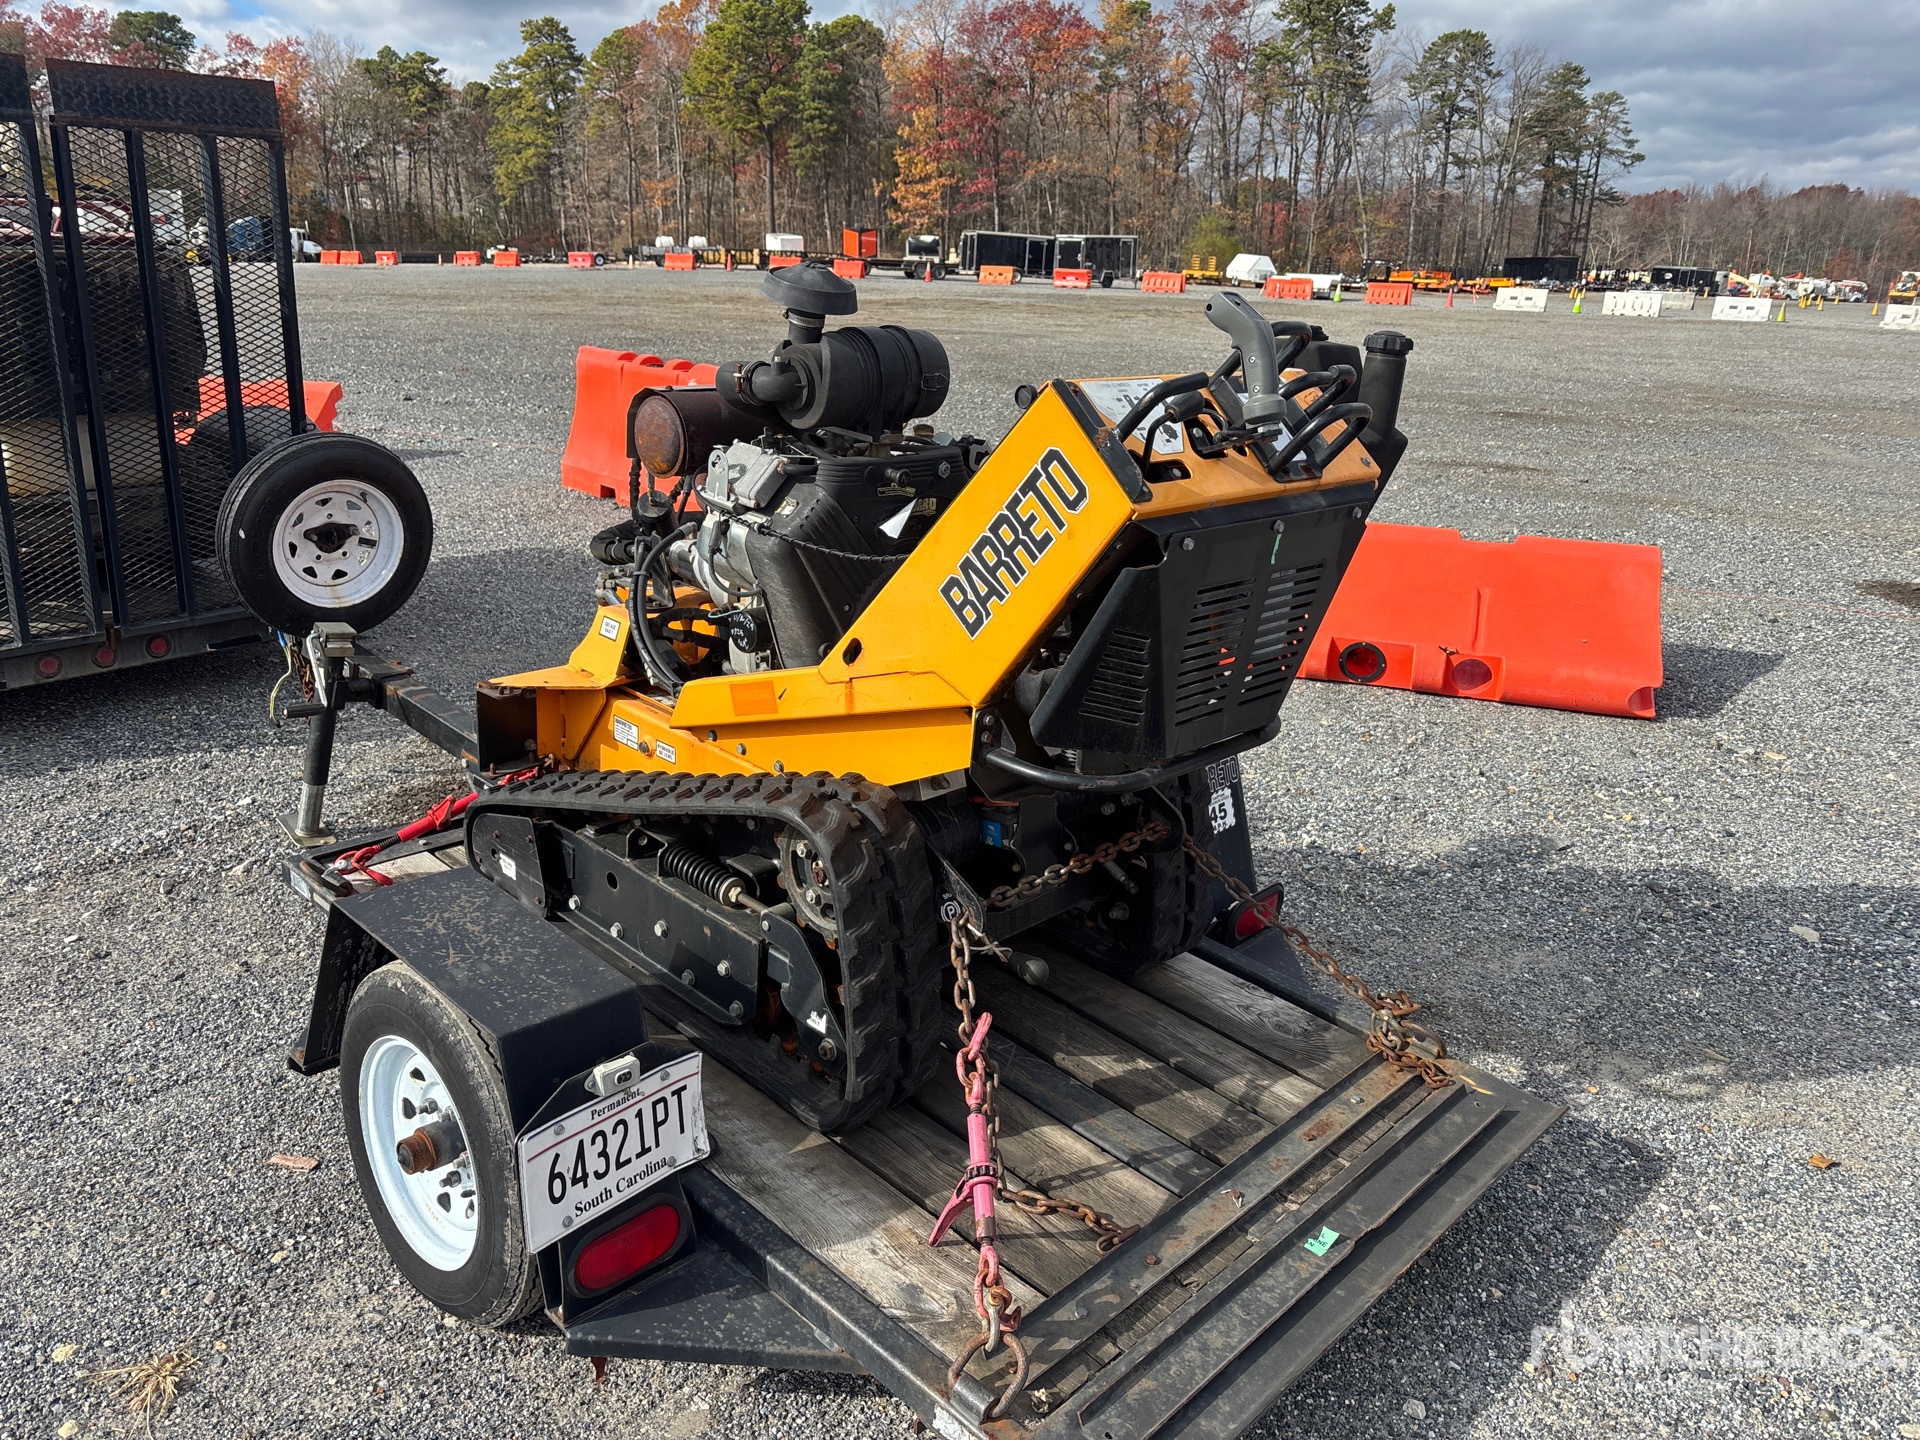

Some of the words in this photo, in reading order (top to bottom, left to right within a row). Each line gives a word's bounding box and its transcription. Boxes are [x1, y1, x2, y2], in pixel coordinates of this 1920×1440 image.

[938, 446, 1089, 640] BARRETO
[1205, 756, 1239, 792] RETO
[1209, 802, 1227, 823] 45
[590, 1087, 641, 1120] Permanent
[547, 1084, 687, 1205] 64321PT
[574, 1189, 613, 1218] South
[616, 1156, 668, 1192] Carolina
